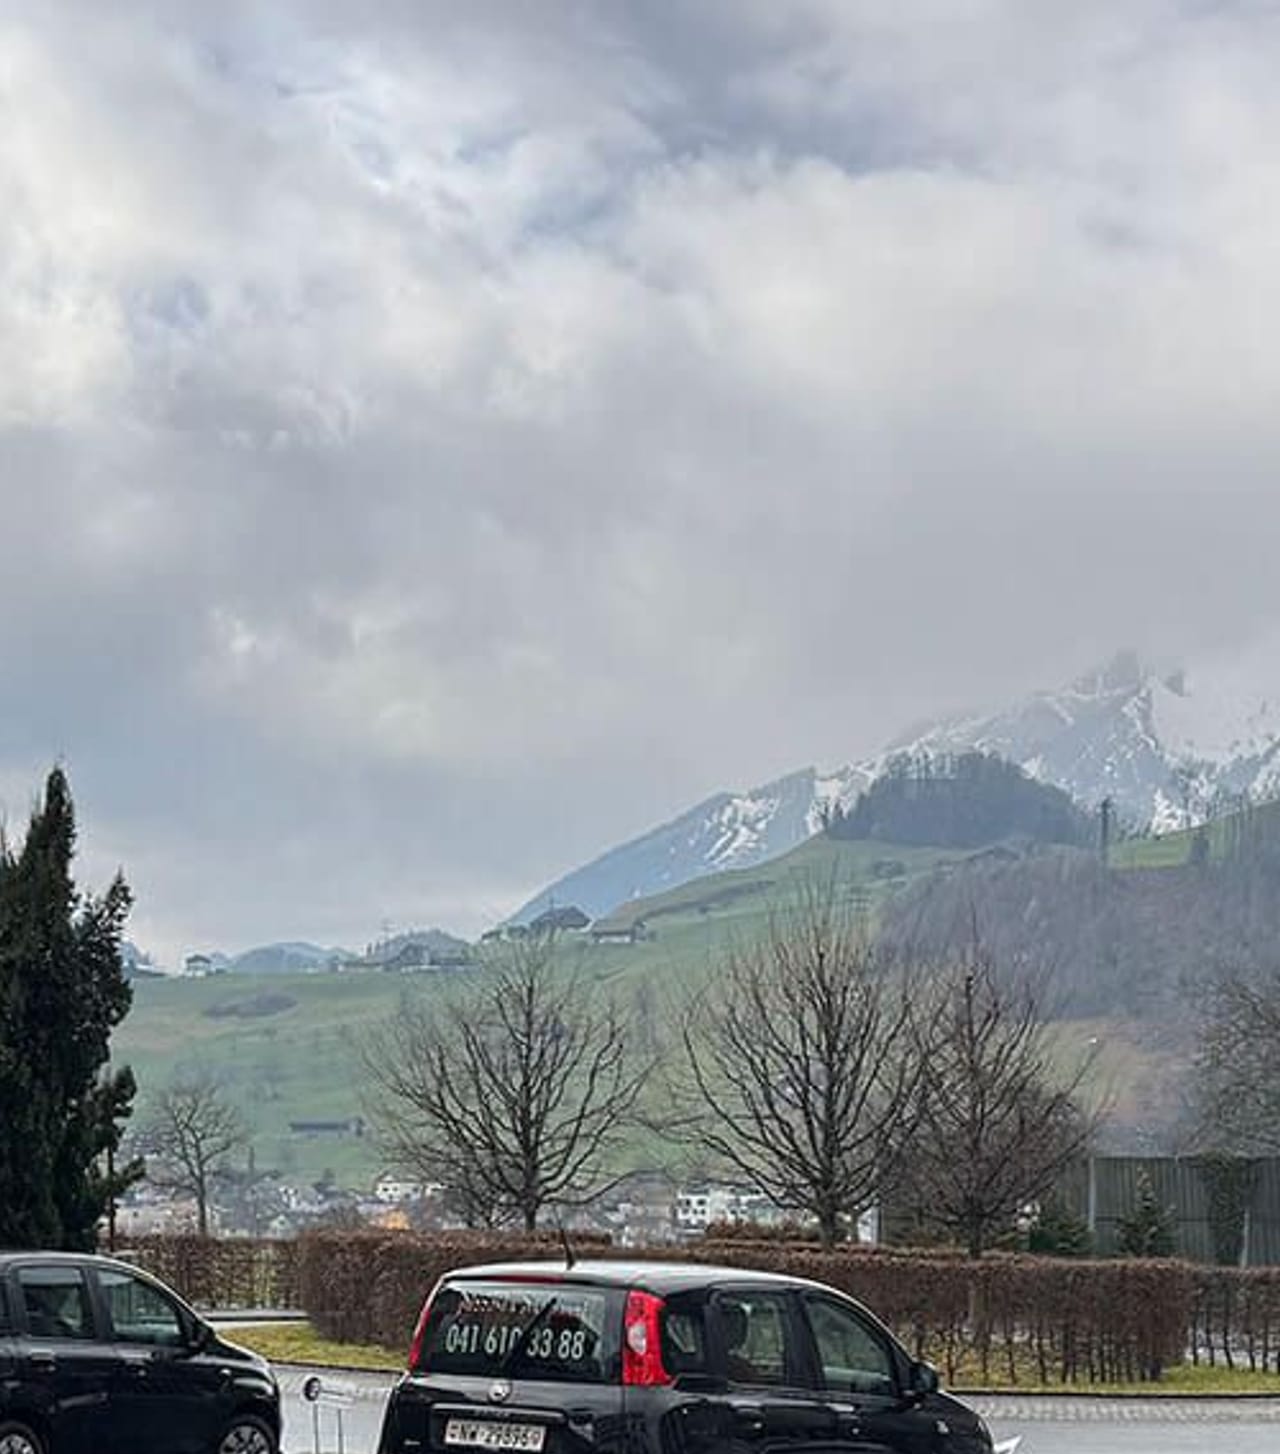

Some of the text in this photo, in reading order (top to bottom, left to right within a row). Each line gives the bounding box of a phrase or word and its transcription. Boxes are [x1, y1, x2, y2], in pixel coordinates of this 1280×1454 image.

[445, 1324, 478, 1354] 041
[527, 1328, 553, 1356] 33
[558, 1330, 585, 1359] 88
